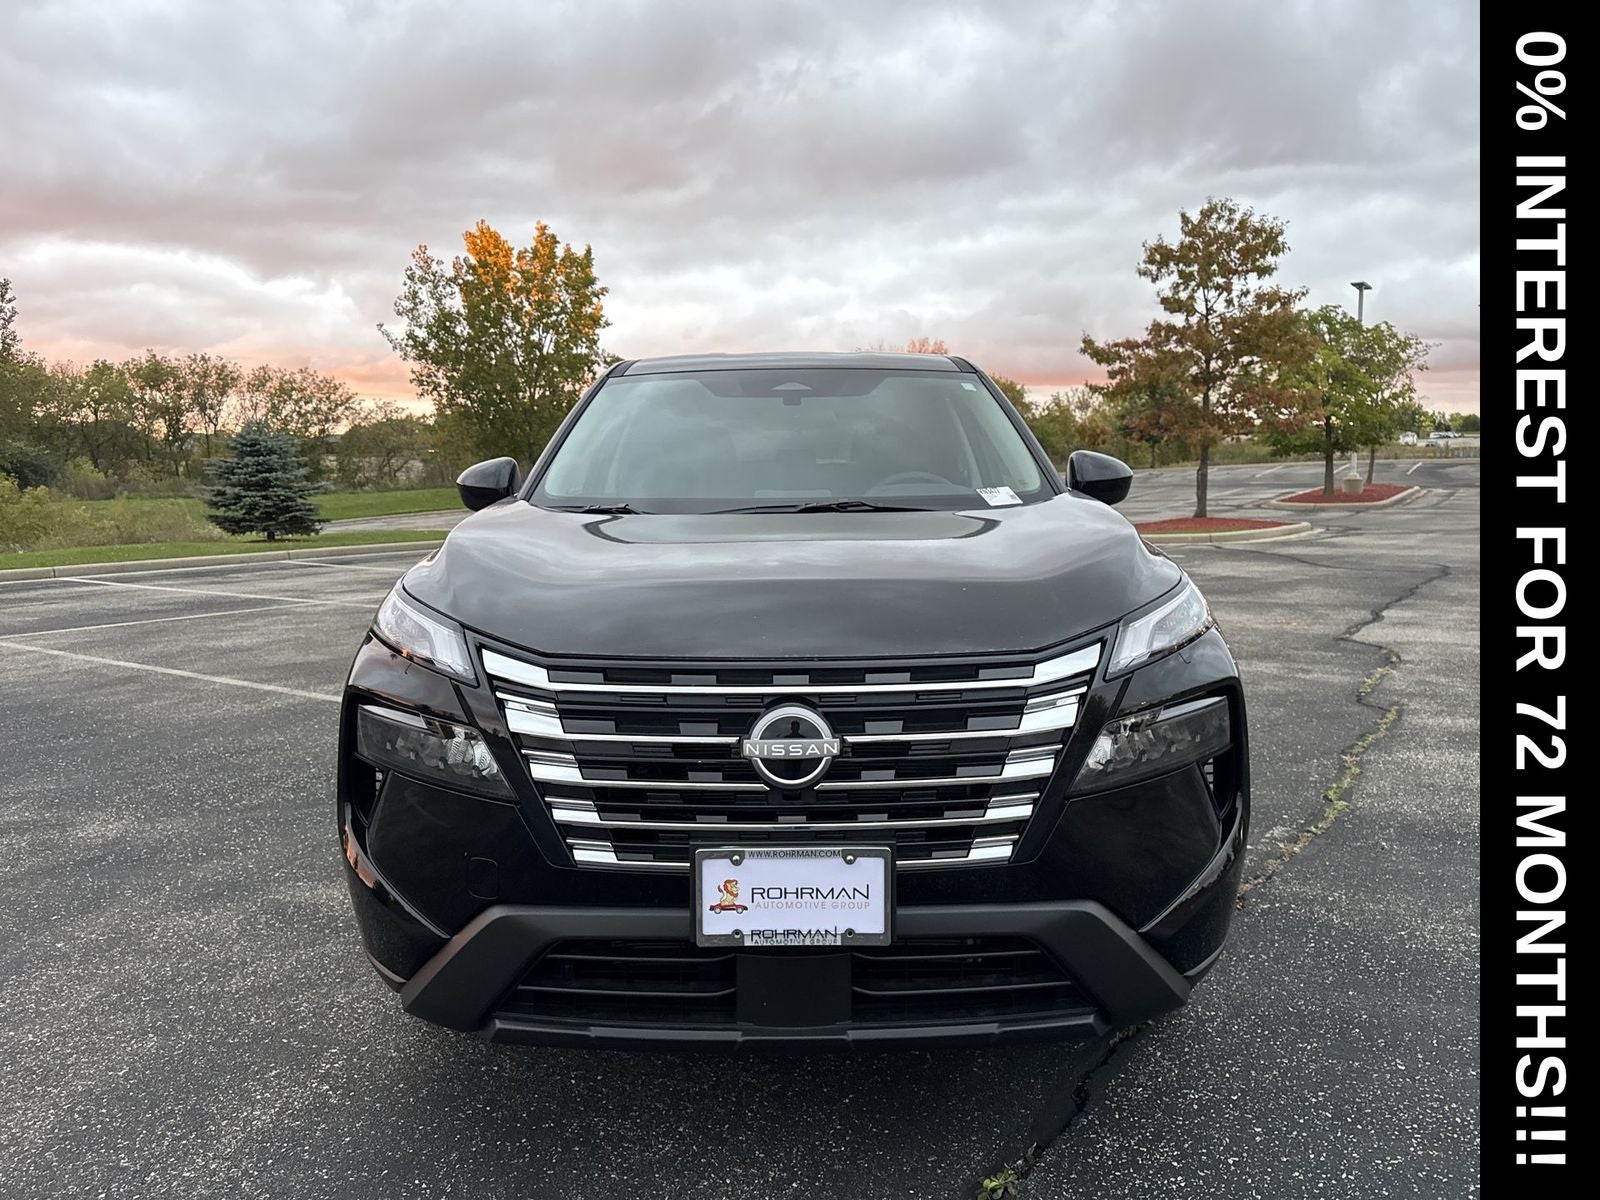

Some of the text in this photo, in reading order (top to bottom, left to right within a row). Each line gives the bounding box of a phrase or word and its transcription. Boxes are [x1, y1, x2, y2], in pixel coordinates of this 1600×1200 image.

[745, 743, 838, 755] NISSAN
[748, 850, 841, 858] WWW.ROHRMAN.COM
[751, 884, 870, 903] ROHRMAN
[750, 926, 838, 942] ROHRMAN
